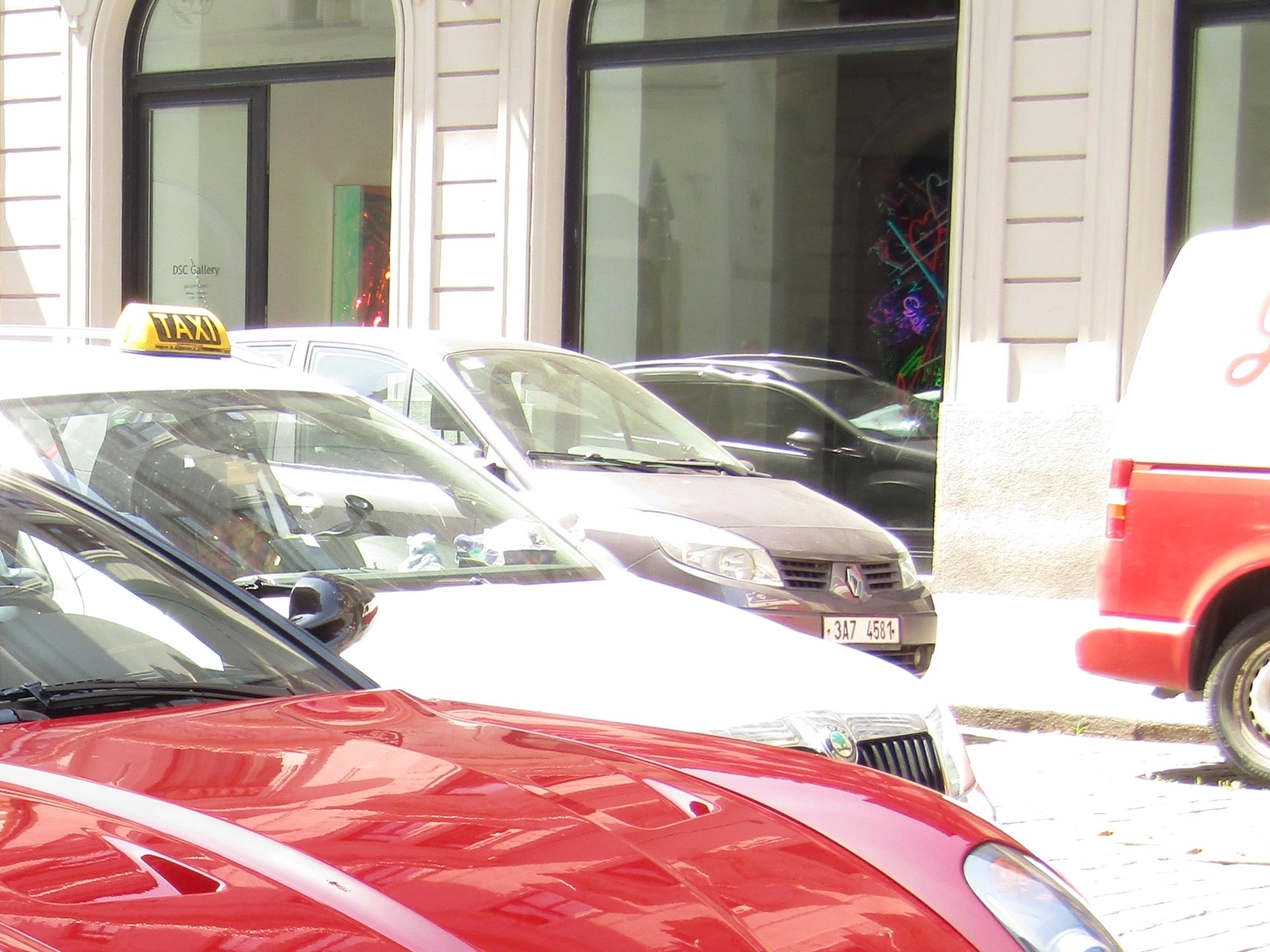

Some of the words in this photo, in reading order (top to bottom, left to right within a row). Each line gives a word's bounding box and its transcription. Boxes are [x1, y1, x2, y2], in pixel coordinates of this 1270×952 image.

[172, 265, 188, 276] DSC
[190, 264, 220, 277] Gallery
[152, 313, 217, 342] TAXI
[834, 620, 857, 640] 3A7
[866, 620, 893, 640] 4581
